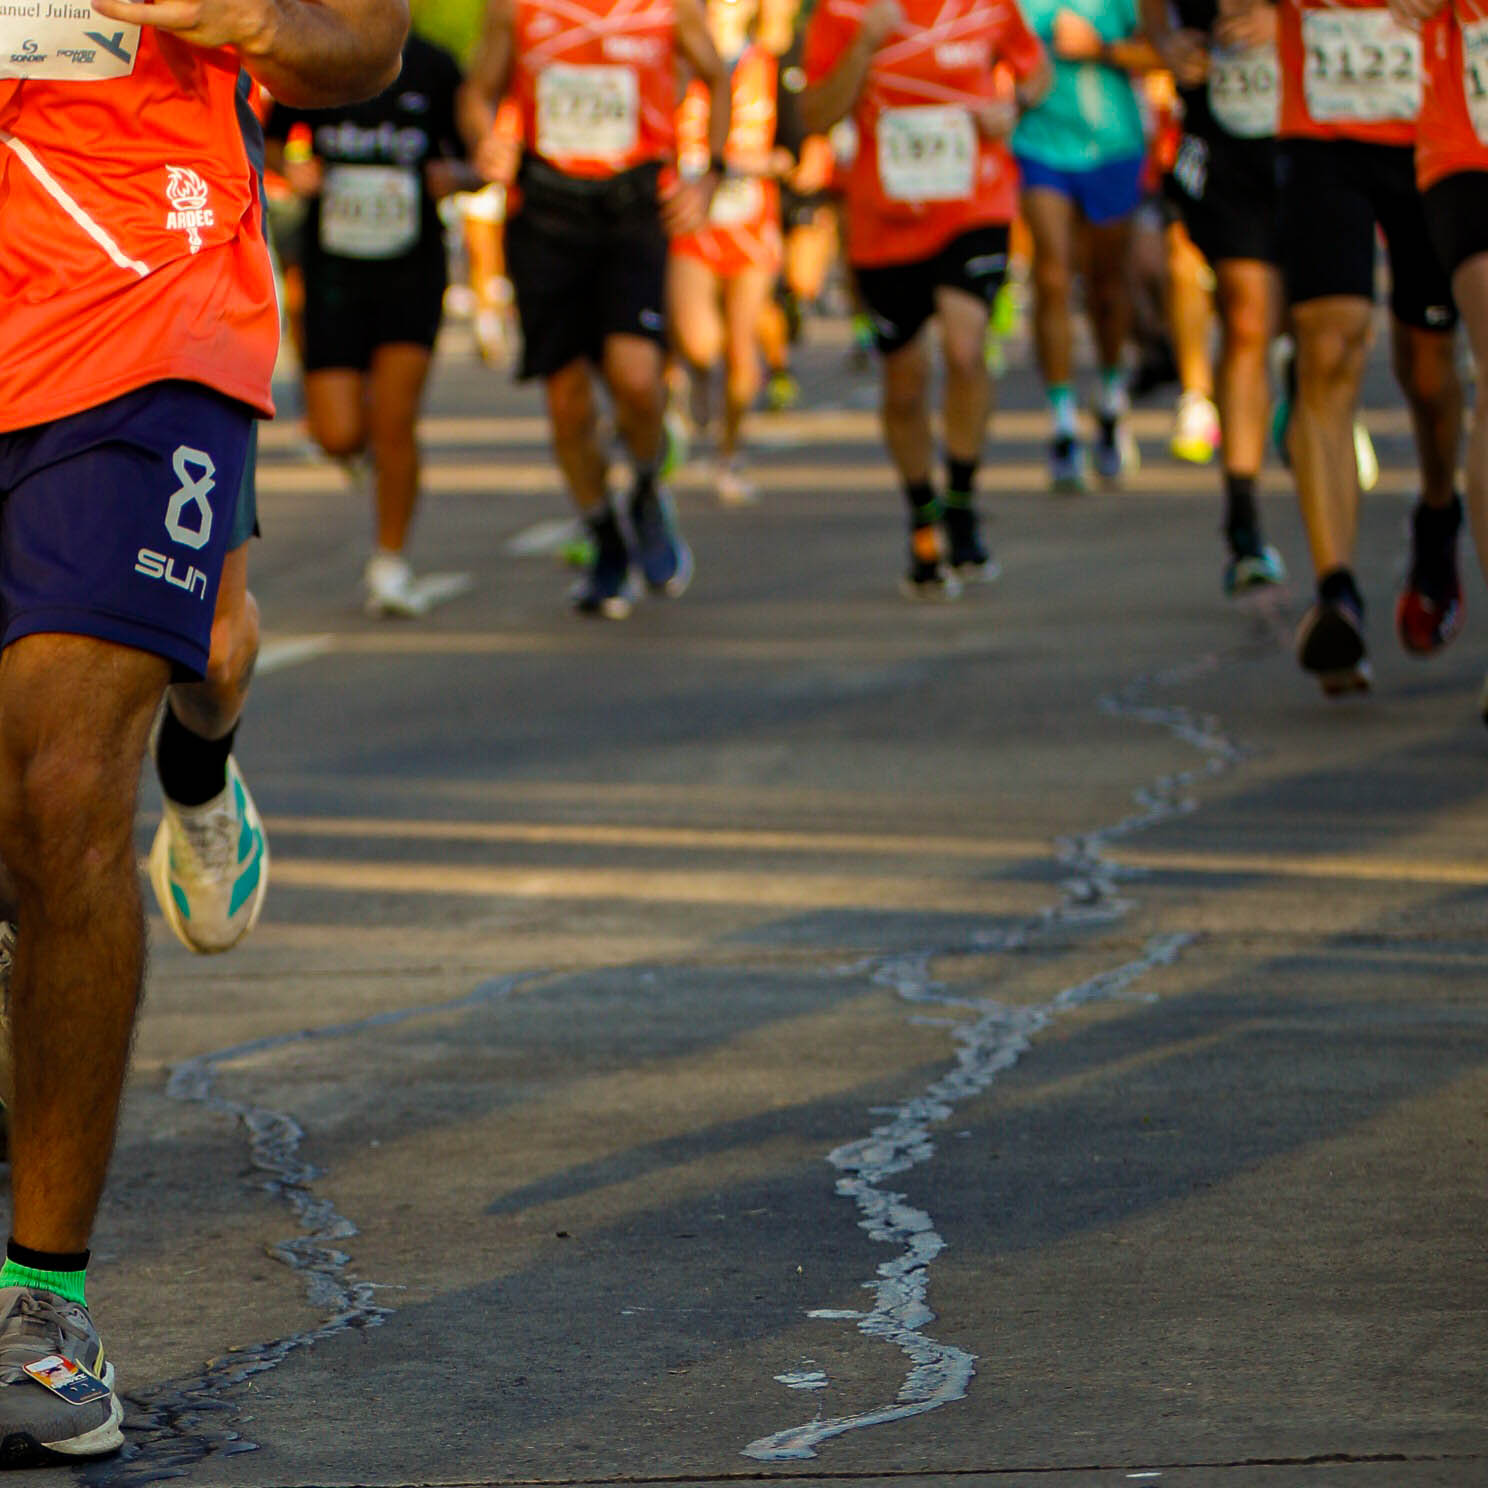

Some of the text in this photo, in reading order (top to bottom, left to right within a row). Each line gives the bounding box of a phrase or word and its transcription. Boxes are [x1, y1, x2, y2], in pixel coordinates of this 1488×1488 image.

[45, 3, 91, 20] Julian
[166, 209, 214, 230] ARDEC
[165, 445, 216, 550] 8
